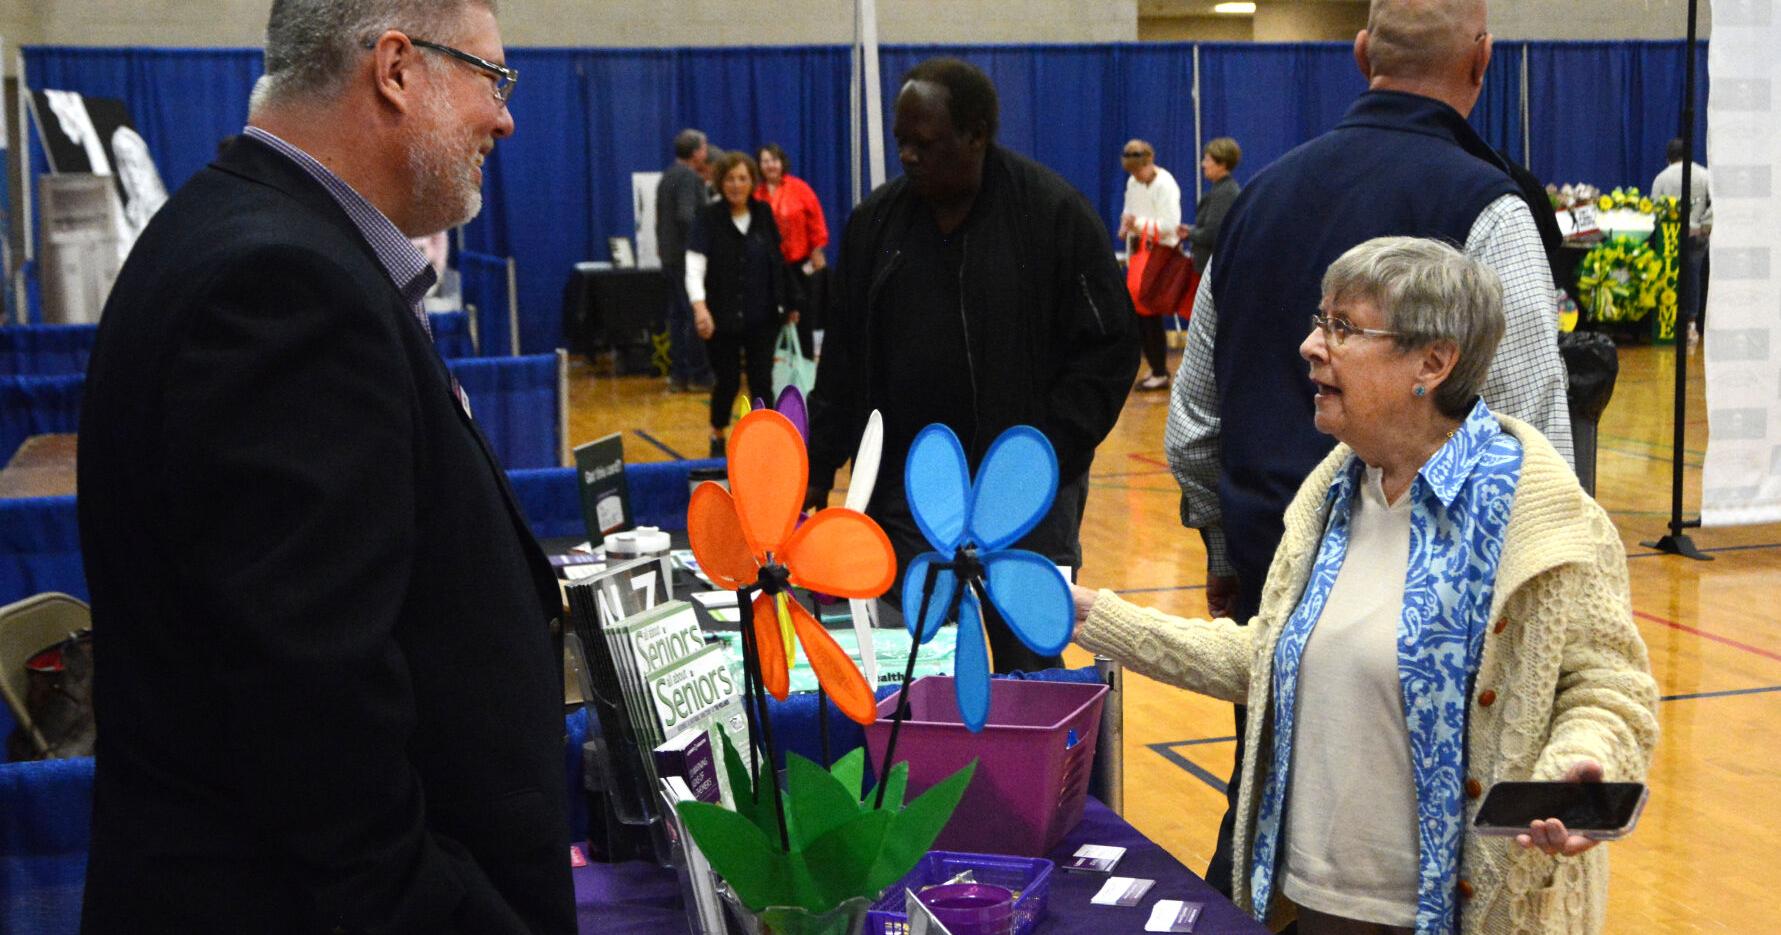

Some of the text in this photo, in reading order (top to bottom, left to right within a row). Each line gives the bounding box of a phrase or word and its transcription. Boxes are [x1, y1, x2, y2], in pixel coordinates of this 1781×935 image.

[1660, 222, 1681, 339] WELCOME
[635, 624, 705, 672] Seniors
[656, 665, 733, 727] Seniors
